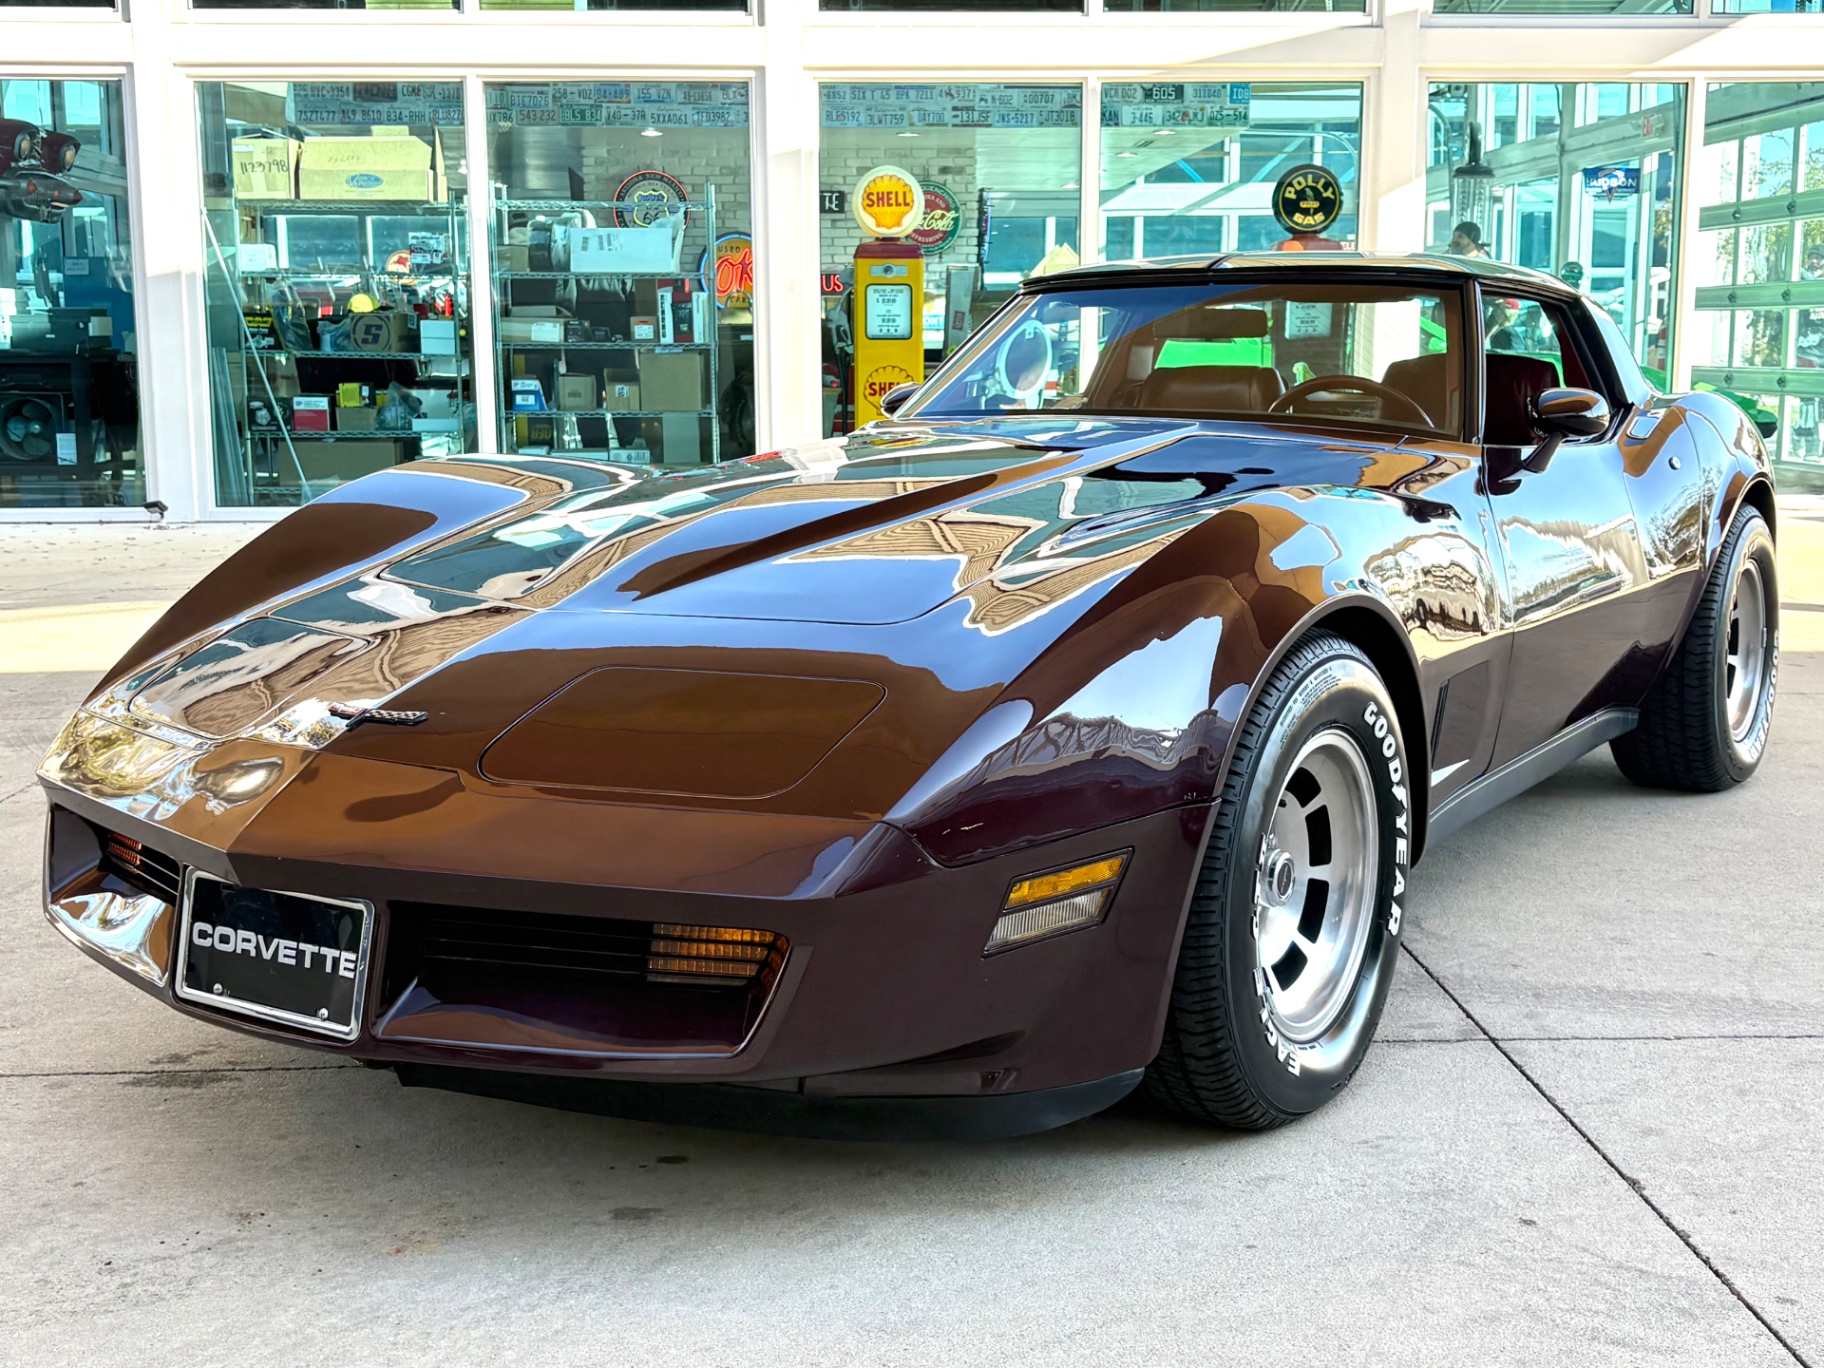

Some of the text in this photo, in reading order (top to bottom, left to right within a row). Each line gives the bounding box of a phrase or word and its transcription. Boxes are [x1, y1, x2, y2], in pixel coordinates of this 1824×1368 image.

[1152, 87, 1176, 100] 605
[519, 110, 557, 121] 543 232
[1284, 174, 1335, 200] POLLY
[866, 191, 910, 207] SHELL
[1293, 212, 1325, 225] GAS
[361, 324, 383, 345] S
[868, 381, 900, 397] SHE
[1363, 701, 1408, 937] GOODYEAR
[192, 921, 358, 980] CORVETTE
